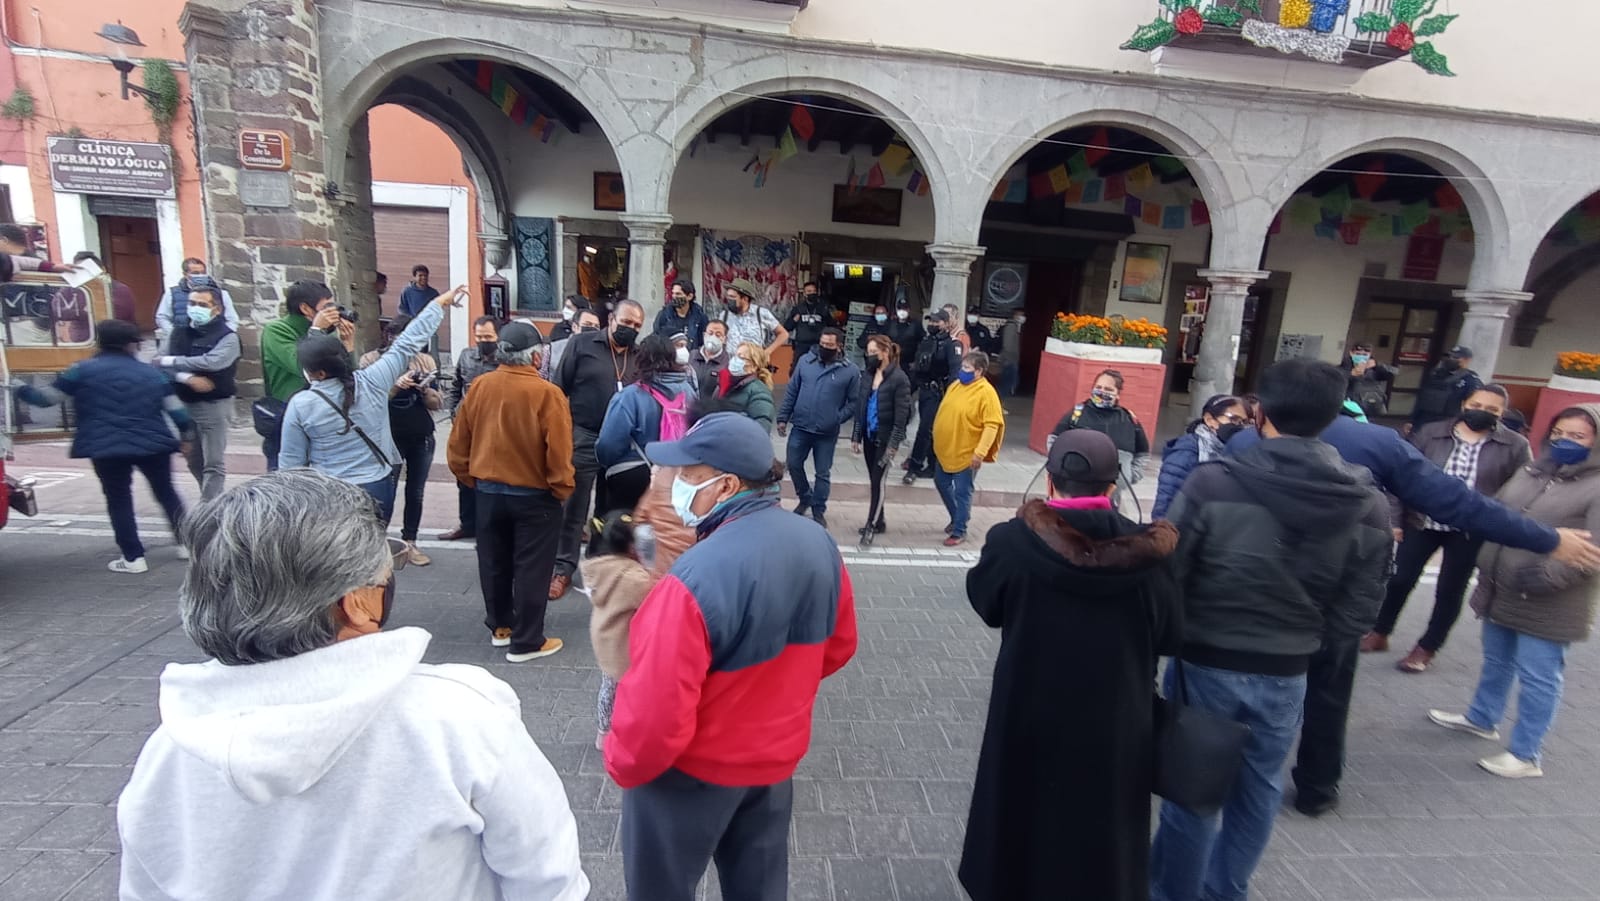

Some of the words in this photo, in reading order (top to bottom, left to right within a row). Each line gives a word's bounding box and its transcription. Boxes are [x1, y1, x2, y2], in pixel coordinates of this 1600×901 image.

[78, 141, 136, 156] CLÍNICA
[52, 154, 166, 170] DERMATOLÓGICA
[244, 156, 282, 164] Constitución
[98, 167, 130, 175] ROMERO
